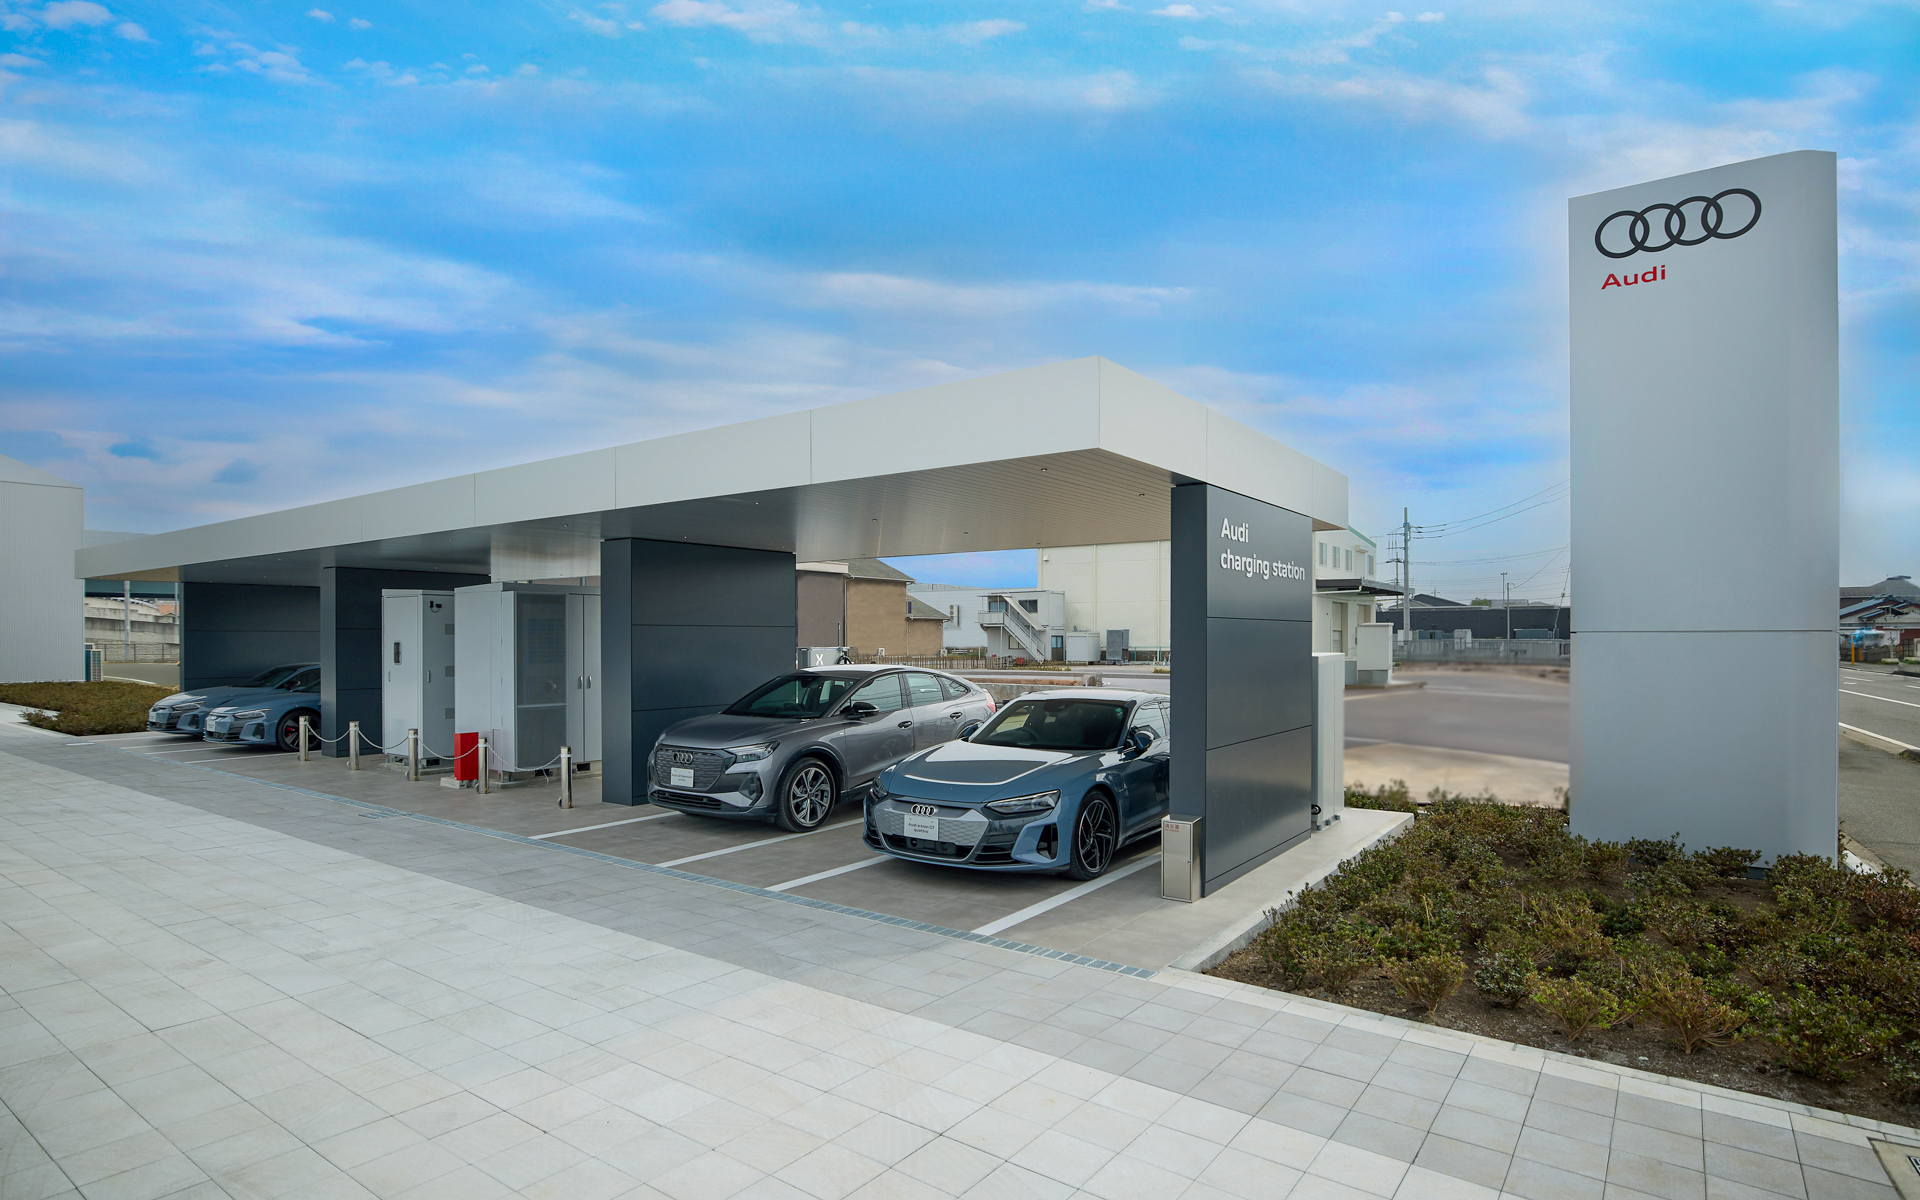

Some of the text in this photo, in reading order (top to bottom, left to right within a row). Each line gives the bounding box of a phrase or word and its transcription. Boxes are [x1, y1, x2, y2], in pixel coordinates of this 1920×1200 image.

[1601, 265, 1666, 290] Audi
[1221, 518, 1249, 543] Audi
[1220, 549, 1305, 580] charging station
